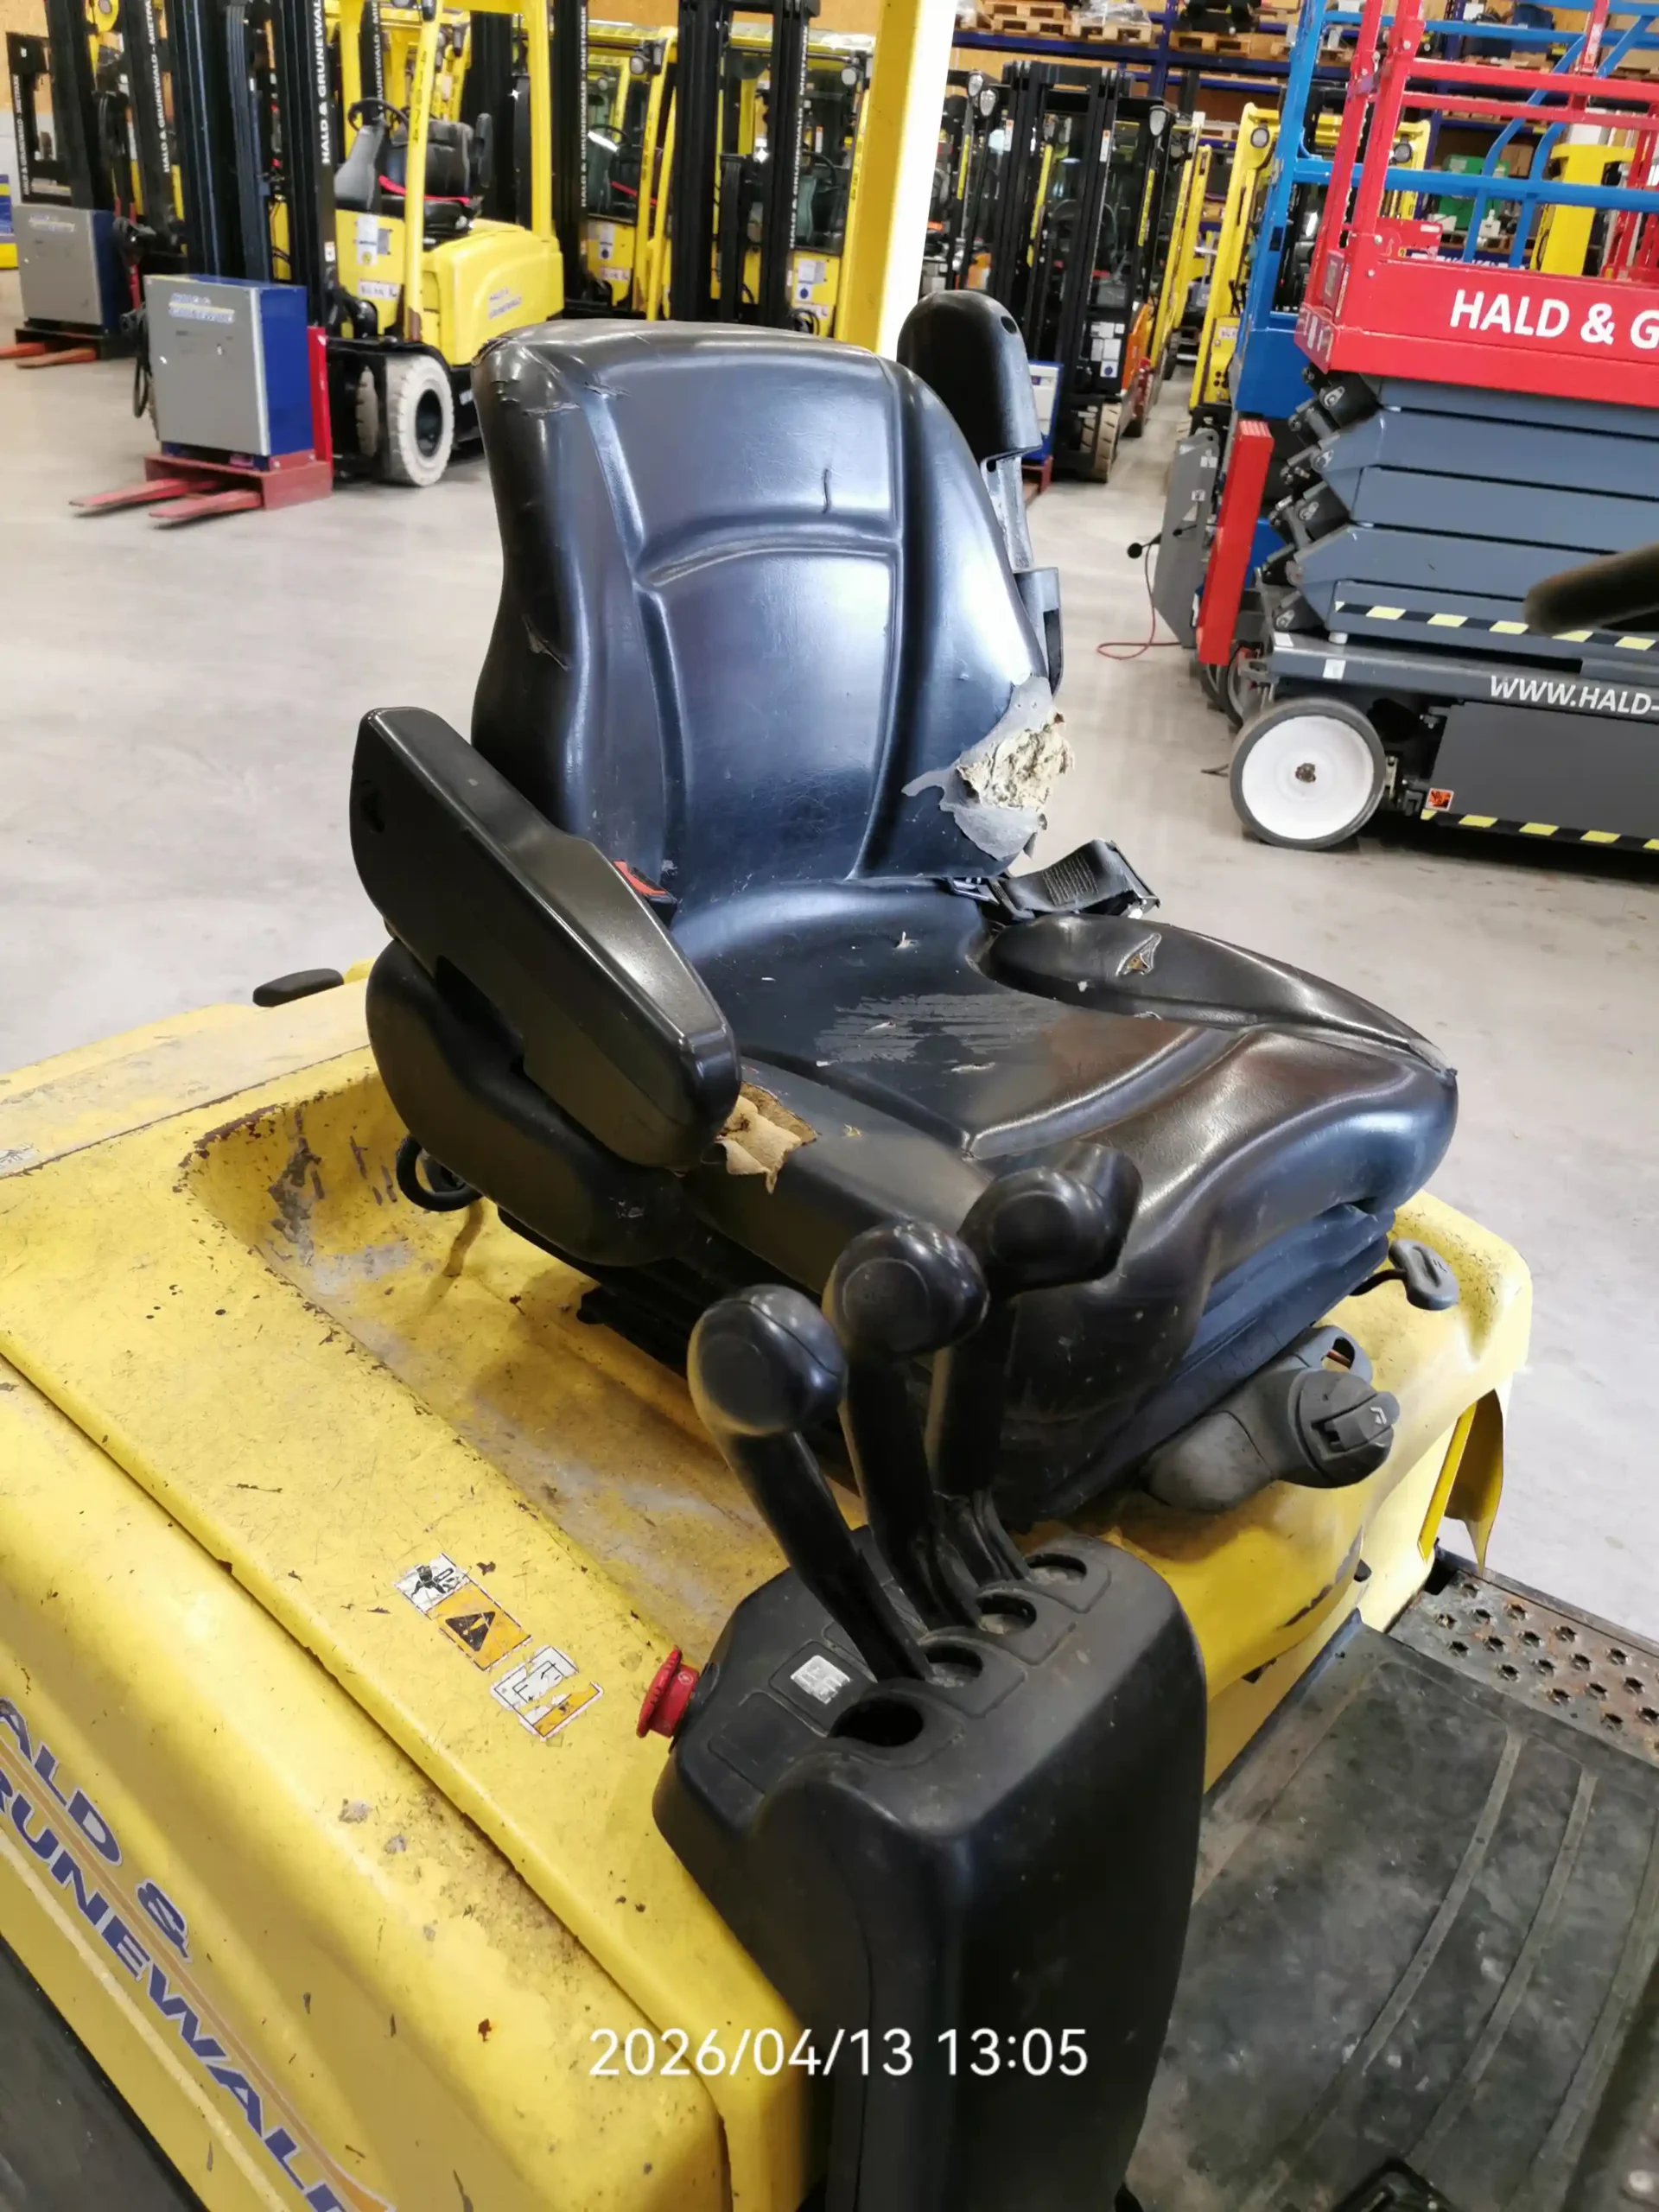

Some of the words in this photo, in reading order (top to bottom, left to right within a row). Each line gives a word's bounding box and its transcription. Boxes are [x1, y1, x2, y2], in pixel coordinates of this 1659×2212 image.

[151, 54, 165, 128] GRUNEWALD
[318, 102, 328, 115] &
[161, 143, 170, 173] HALD
[320, 119, 331, 165] HALD
[1450, 289, 1569, 338] HALD
[1580, 302, 1615, 345] &
[1630, 309, 1659, 349] G
[136, 1879, 192, 1961] &
